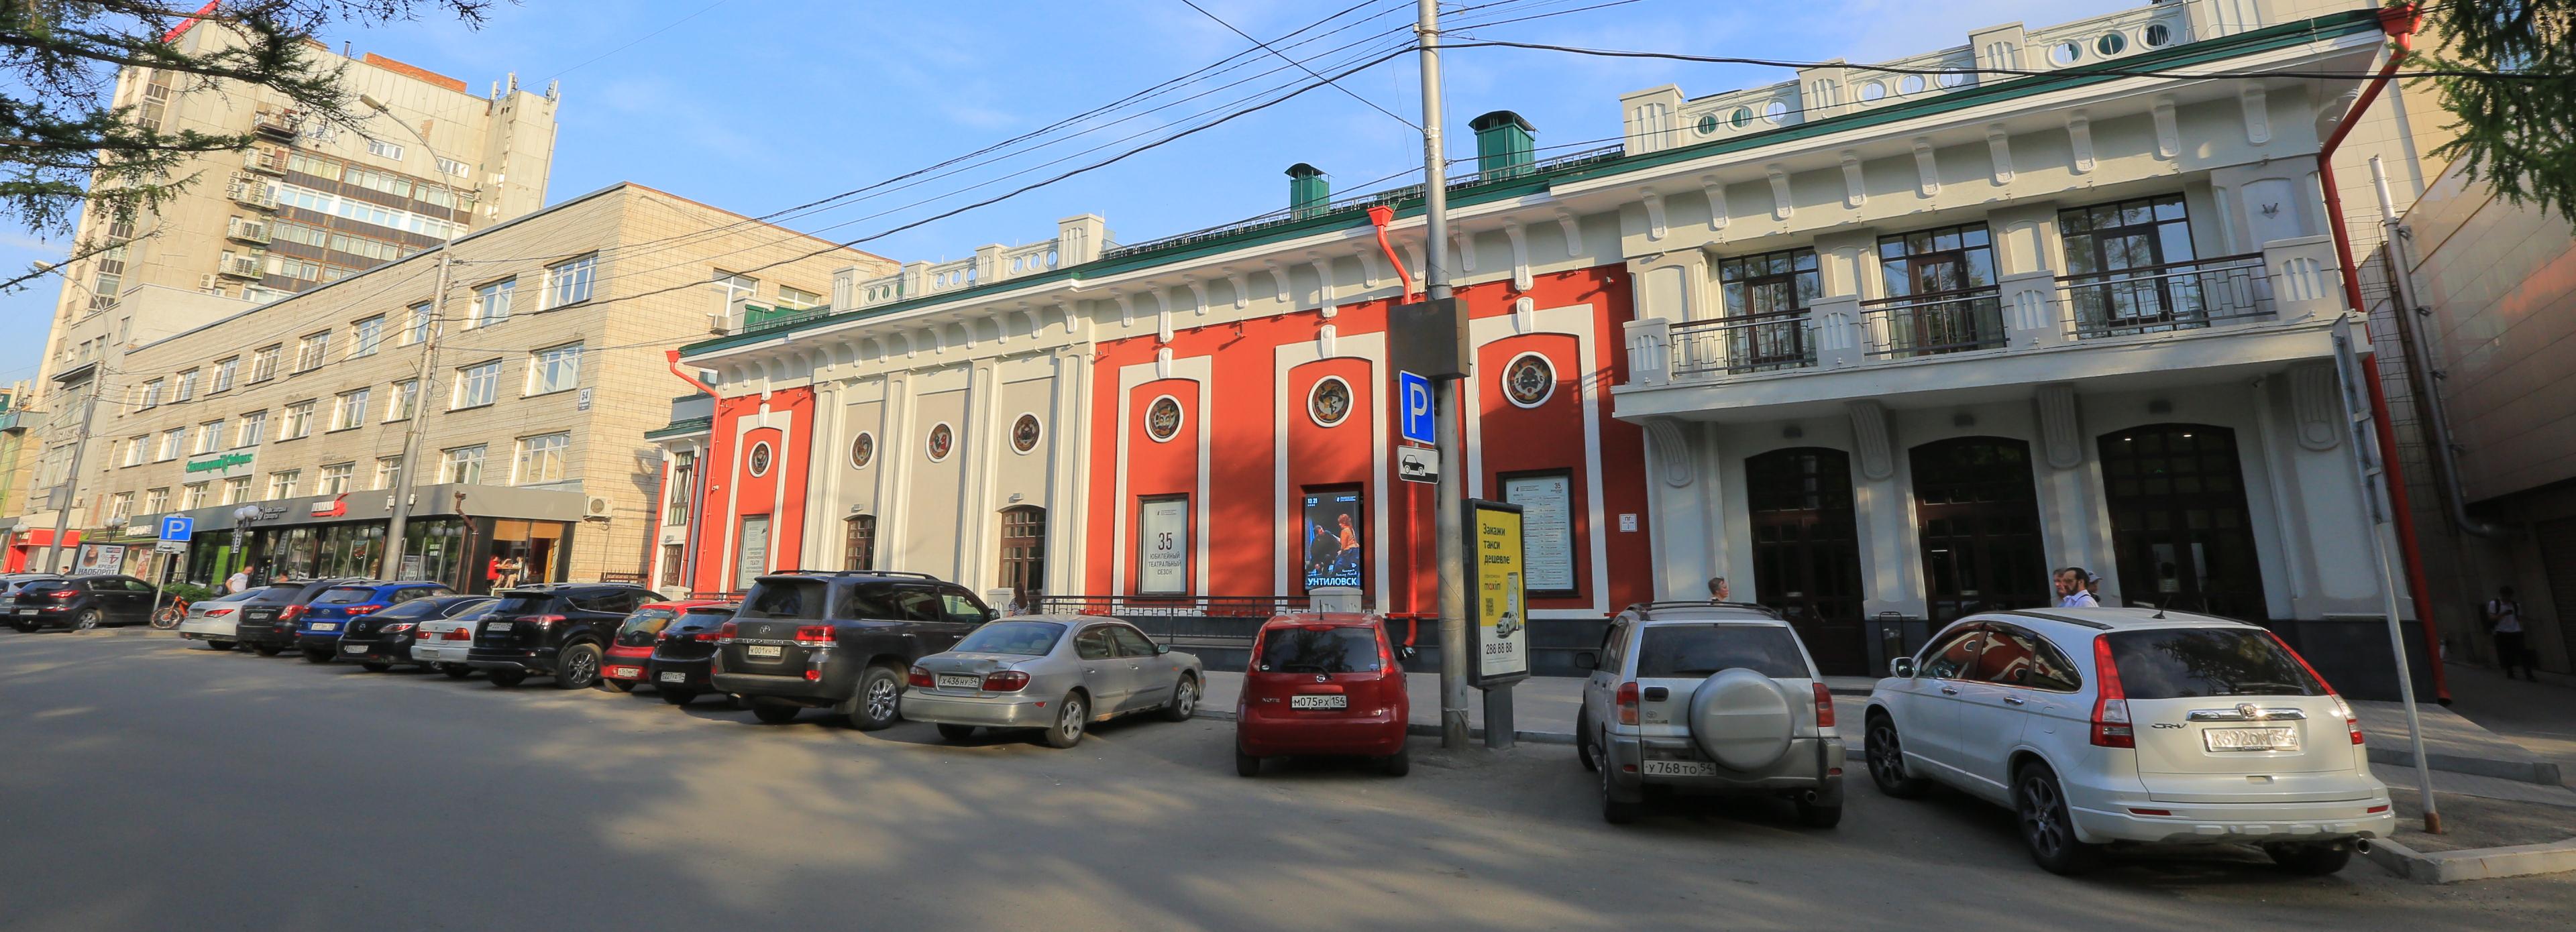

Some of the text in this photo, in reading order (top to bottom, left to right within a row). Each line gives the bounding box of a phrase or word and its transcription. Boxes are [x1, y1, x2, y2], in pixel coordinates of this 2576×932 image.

[582, 391, 589, 401] 54
[1410, 382, 1428, 434] P
[167, 520, 185, 539] P
[1483, 523, 1505, 536] Закажи
[1158, 532, 1173, 550] 35
[1483, 540, 1501, 550] такси
[1150, 551, 1180, 560] ЮБИЛЕЙНЫЙ
[1484, 554, 1510, 565] дешевле
[1148, 560, 1181, 568] ТЕАТРАЛЬНЫЙ
[1307, 577, 1357, 586] УНТИЛОВСК
[1484, 581, 1501, 591] maxim
[1486, 642, 1513, 654] 288 88 88
[1700, 763, 1713, 772] 54
